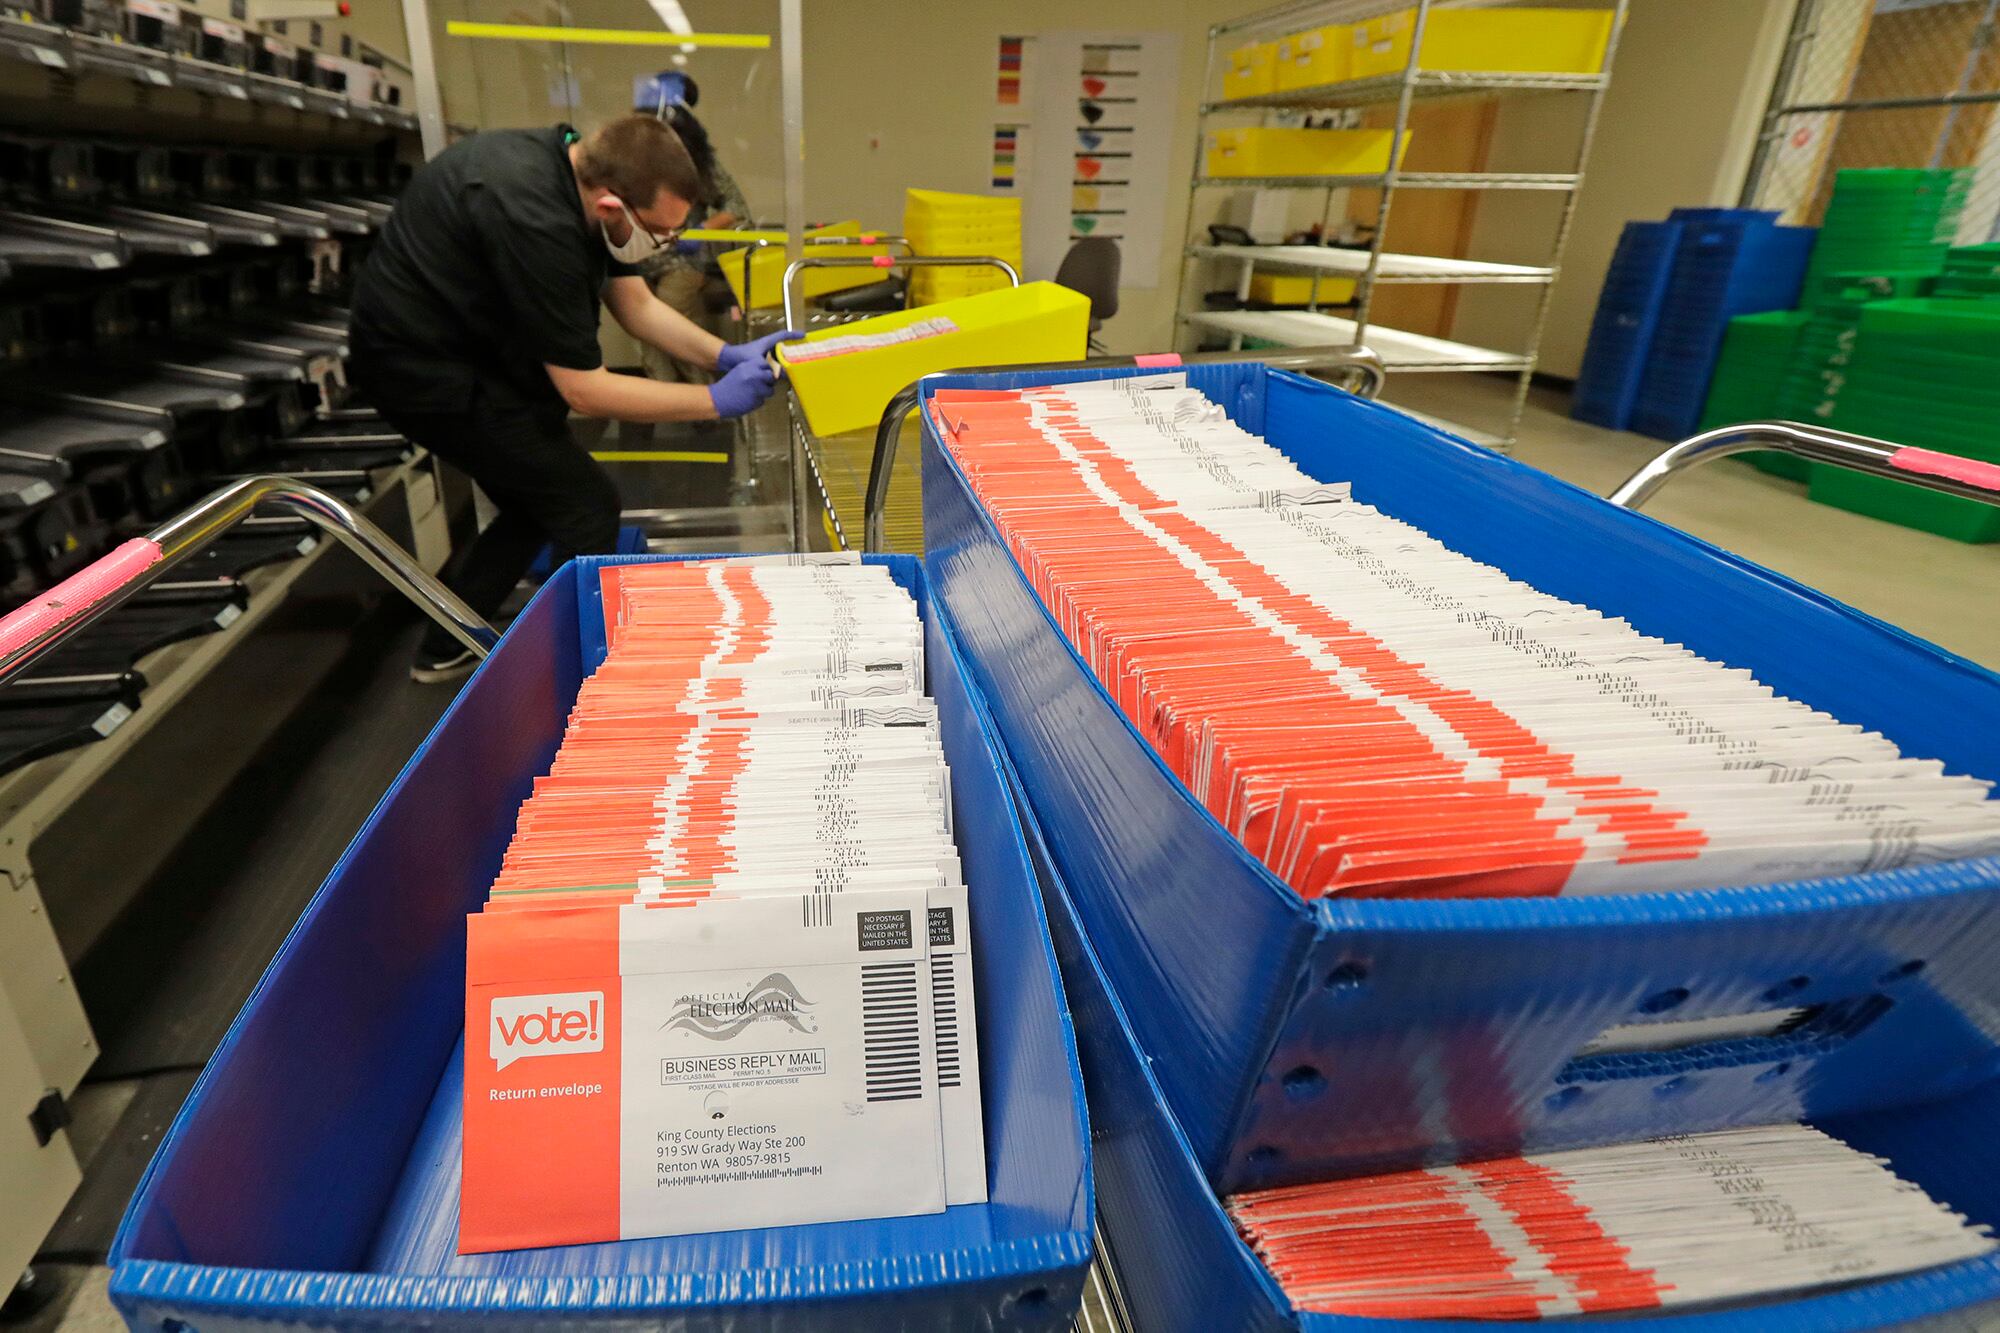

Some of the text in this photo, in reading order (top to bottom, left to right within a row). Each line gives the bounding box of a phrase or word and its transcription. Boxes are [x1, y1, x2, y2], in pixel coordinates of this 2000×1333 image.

[864, 923, 898, 931] NECESSARY
[876, 914, 904, 922] POSTAGE
[862, 931, 886, 939] MAILED
[886, 938, 909, 946] STATES
[681, 991, 741, 1002] OFFICIAL
[690, 999, 798, 1018] ELECTION MAIL
[495, 999, 598, 1046] vote!
[665, 1052, 821, 1074] BUSINESS REPLY MAIL
[489, 1083, 602, 1101] Return envelope
[689, 1083, 717, 1091] POSTAGE
[764, 1078, 800, 1086] ADDRESSEE
[657, 1124, 777, 1143] King County Elections
[657, 1136, 806, 1158] 919 SW Grady Way Ste 200
[657, 1152, 791, 1173] Renton WA 98057-9815
